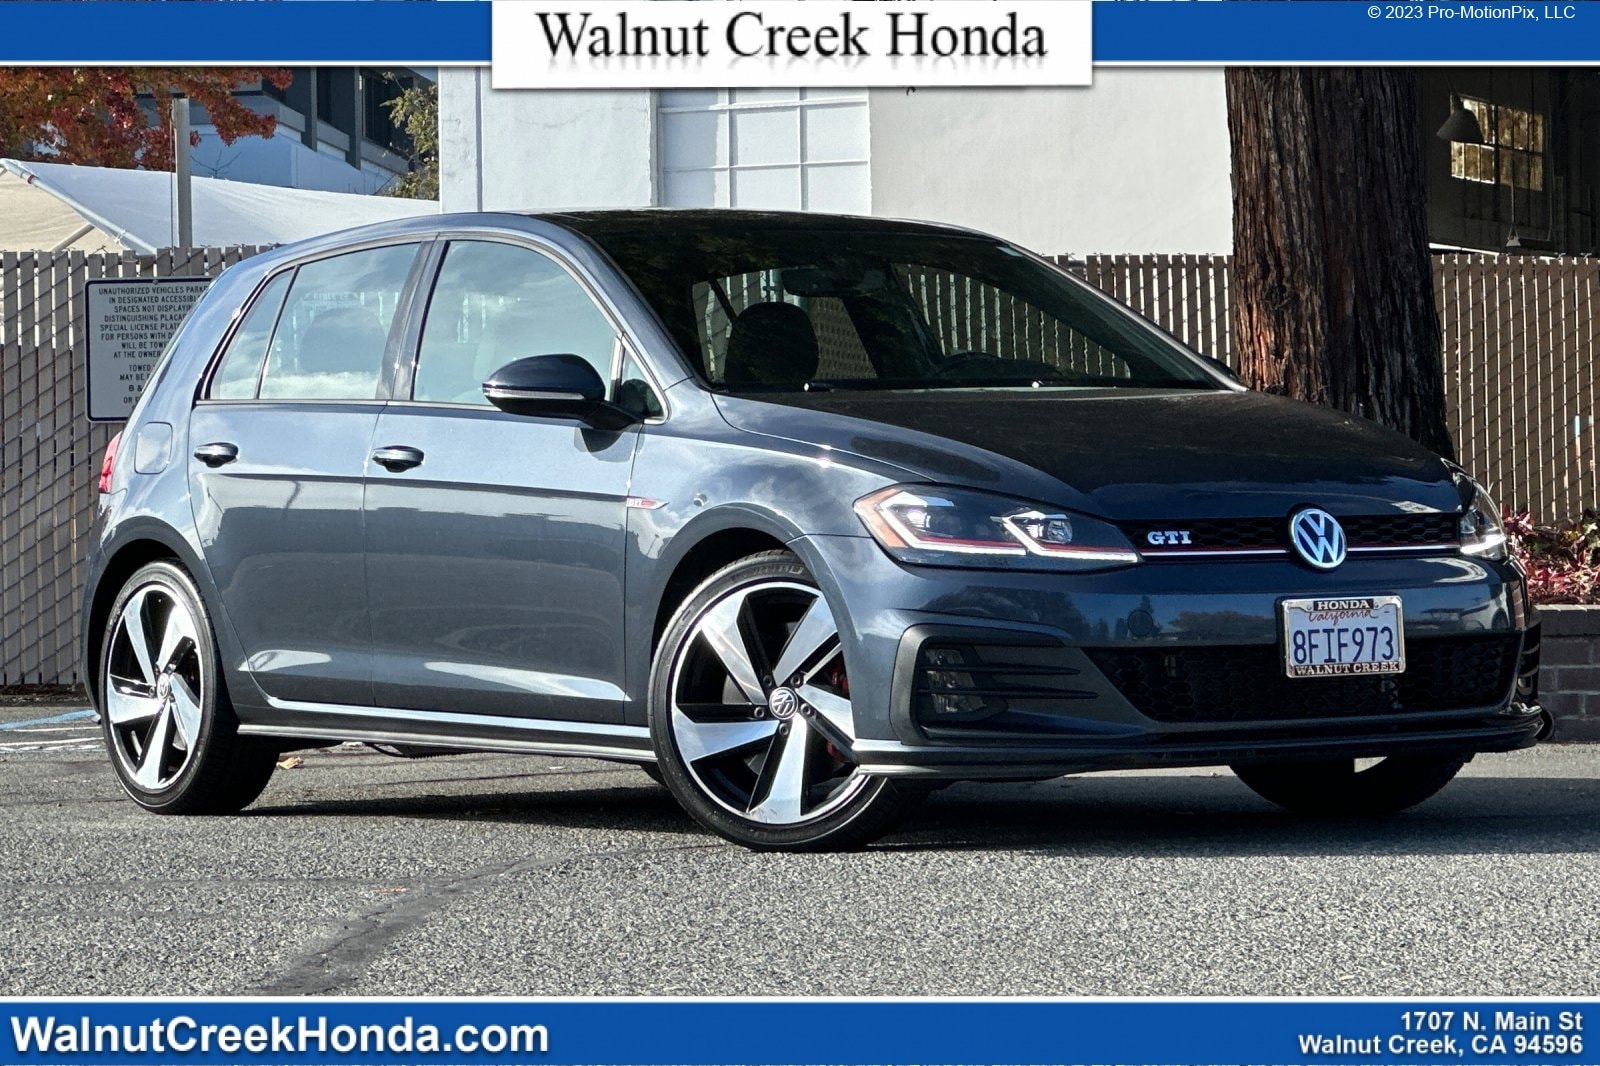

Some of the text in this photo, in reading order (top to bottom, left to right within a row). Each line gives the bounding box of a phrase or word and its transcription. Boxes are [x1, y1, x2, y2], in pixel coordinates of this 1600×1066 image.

[99, 287, 150, 295] UNAUTHORIZED
[152, 286, 184, 294] VEHICLES
[109, 296, 116, 304] IN
[118, 295, 159, 303] DESIGNATED
[114, 304, 140, 313] SPACES
[142, 304, 155, 312] NOT
[104, 314, 158, 322] DISTINGUISHING
[100, 323, 128, 332] SPECIAL
[130, 323, 158, 331] LICENSE
[101, 332, 115, 341] FOR
[117, 332, 148, 340] PERSONS
[150, 331, 166, 340] WITH
[121, 341, 137, 349] WILL
[139, 341, 148, 349] BE
[113, 351, 122, 359] AT
[129, 364, 151, 372] TOWED
[136, 373, 145, 381] BE
[123, 396, 133, 404] OR
[1147, 531, 1192, 545] GTI
[1318, 600, 1370, 610] HONDA
[1293, 626, 1394, 664] 8FIF973
[1295, 661, 1399, 675] WALNUT CREEK
